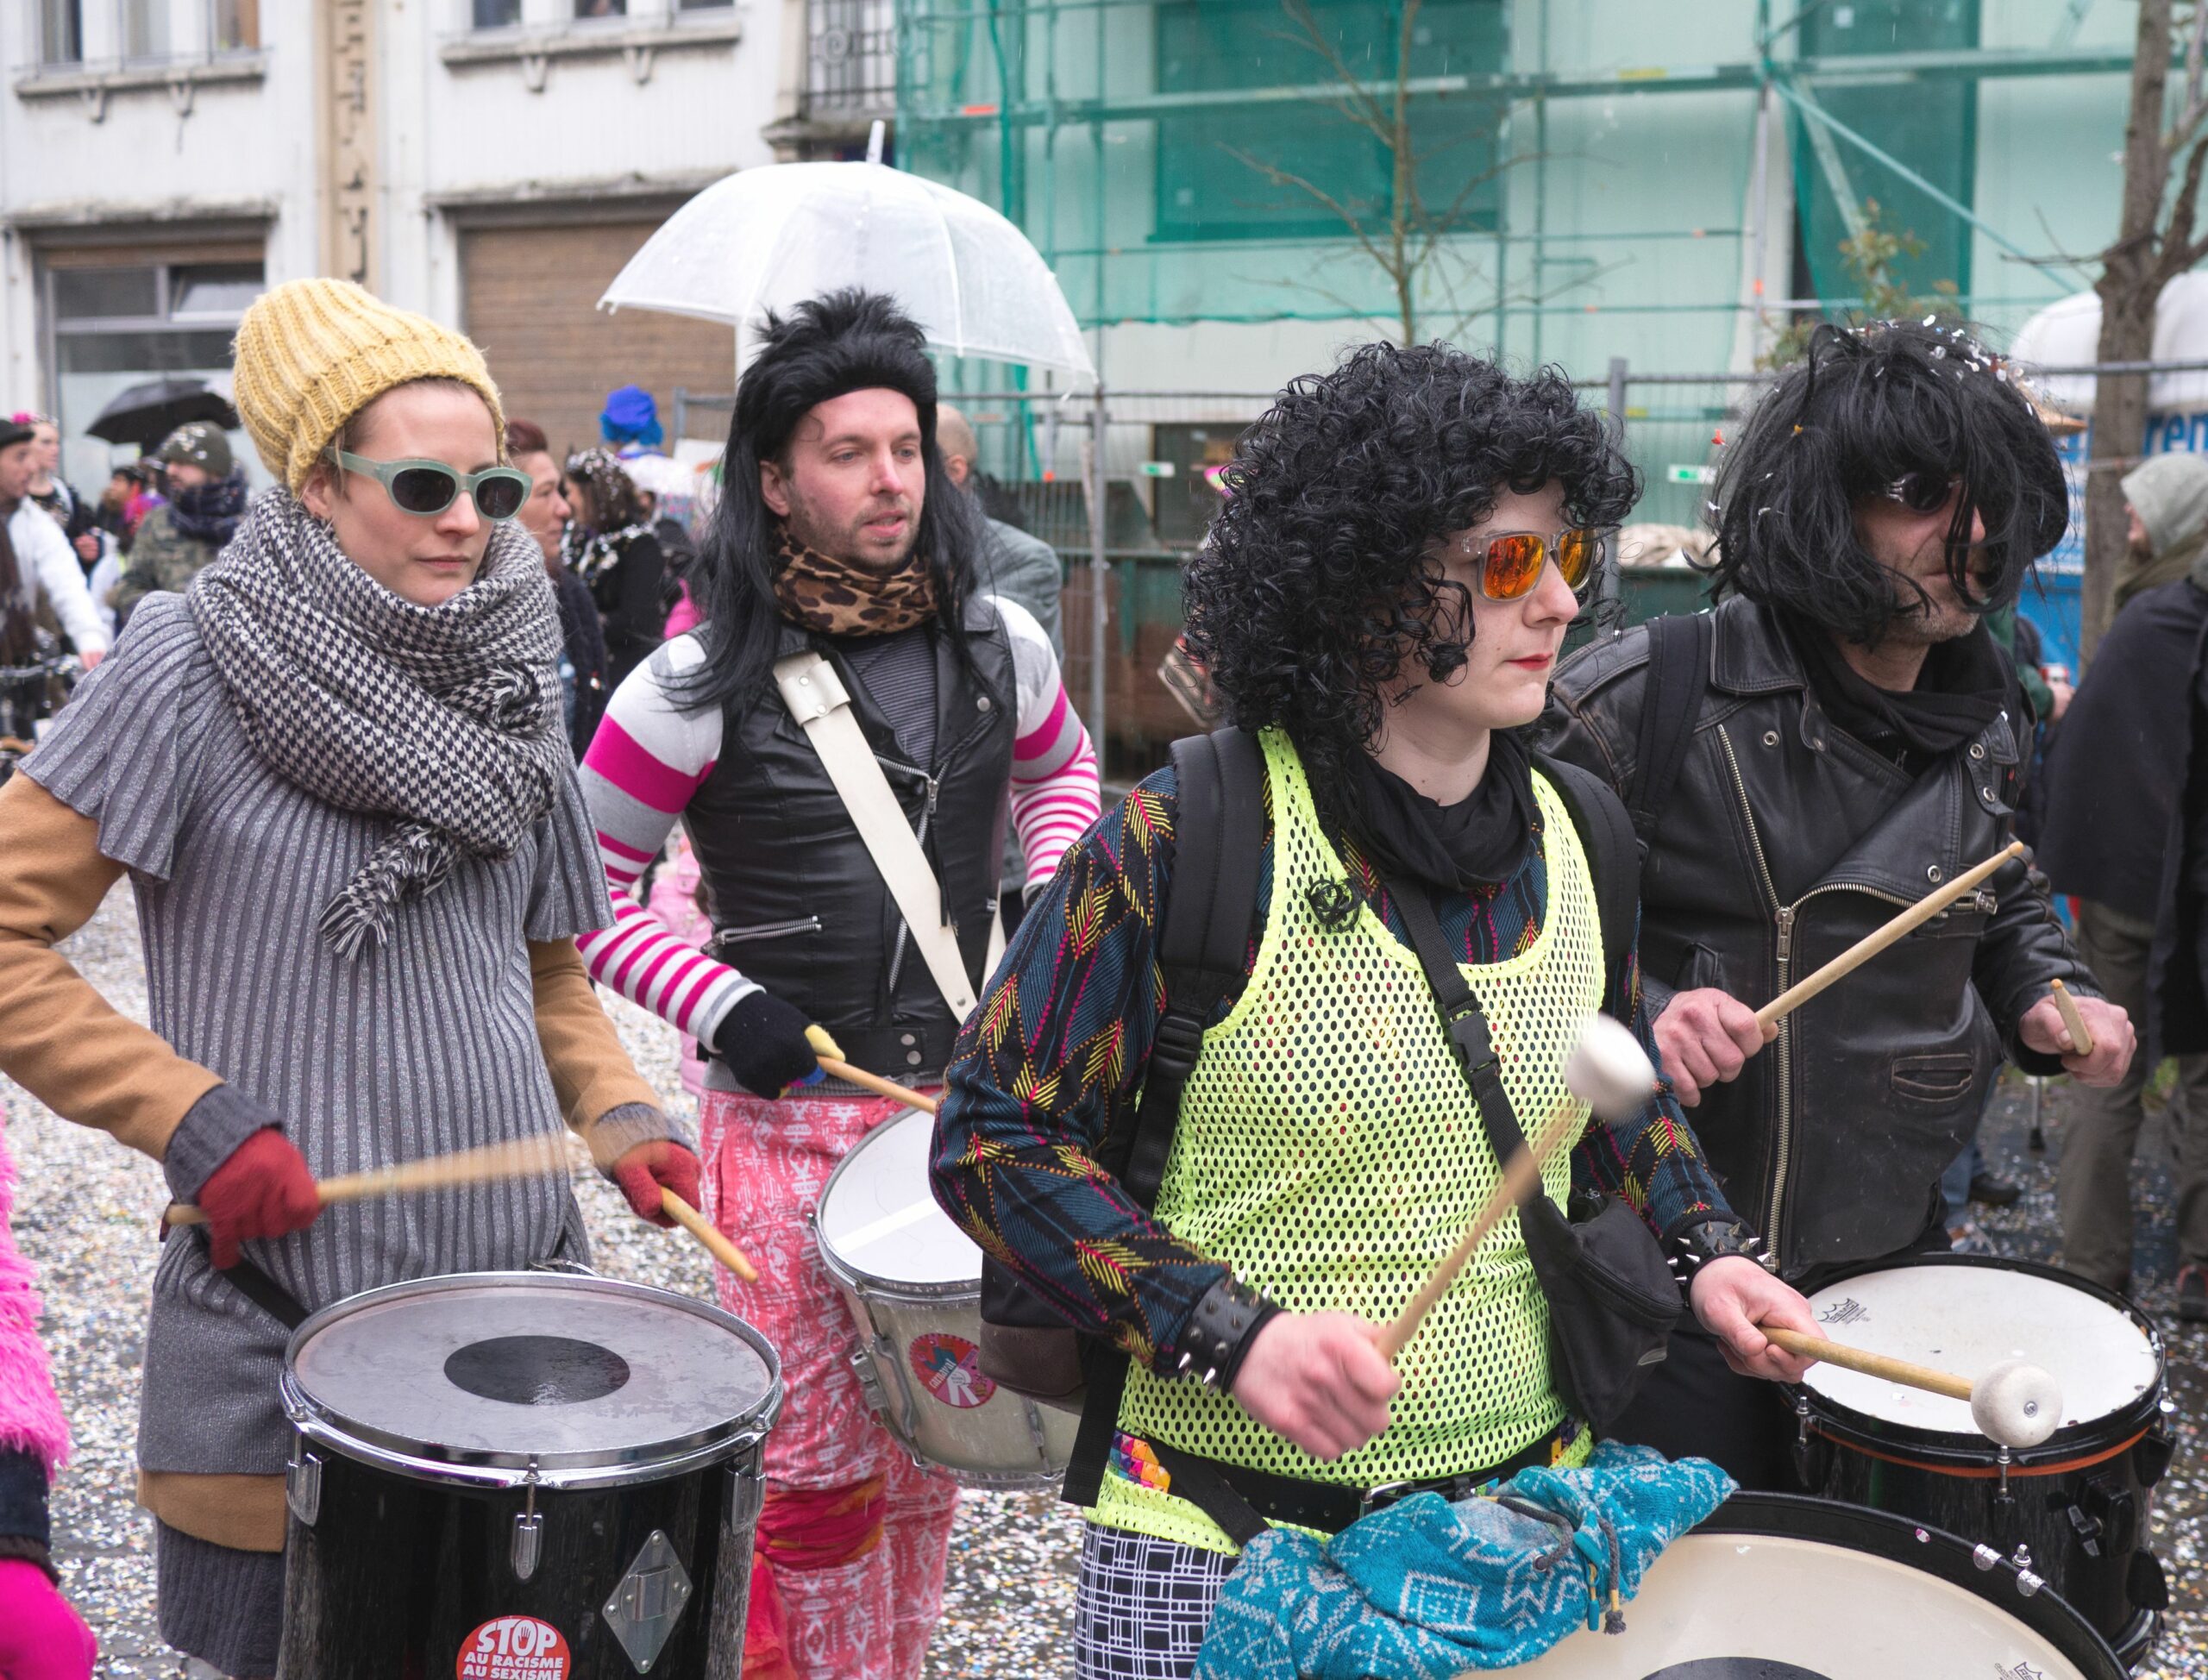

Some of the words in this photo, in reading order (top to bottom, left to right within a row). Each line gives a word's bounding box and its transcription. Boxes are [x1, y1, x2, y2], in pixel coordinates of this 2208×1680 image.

[928, 1357, 957, 1389] carnaval
[476, 1619, 558, 1657] STOP
[462, 1664, 487, 1677] AU
[490, 1667, 561, 1680] SEXISME
[464, 1652, 489, 1664] AU
[492, 1655, 563, 1669] RACISME
